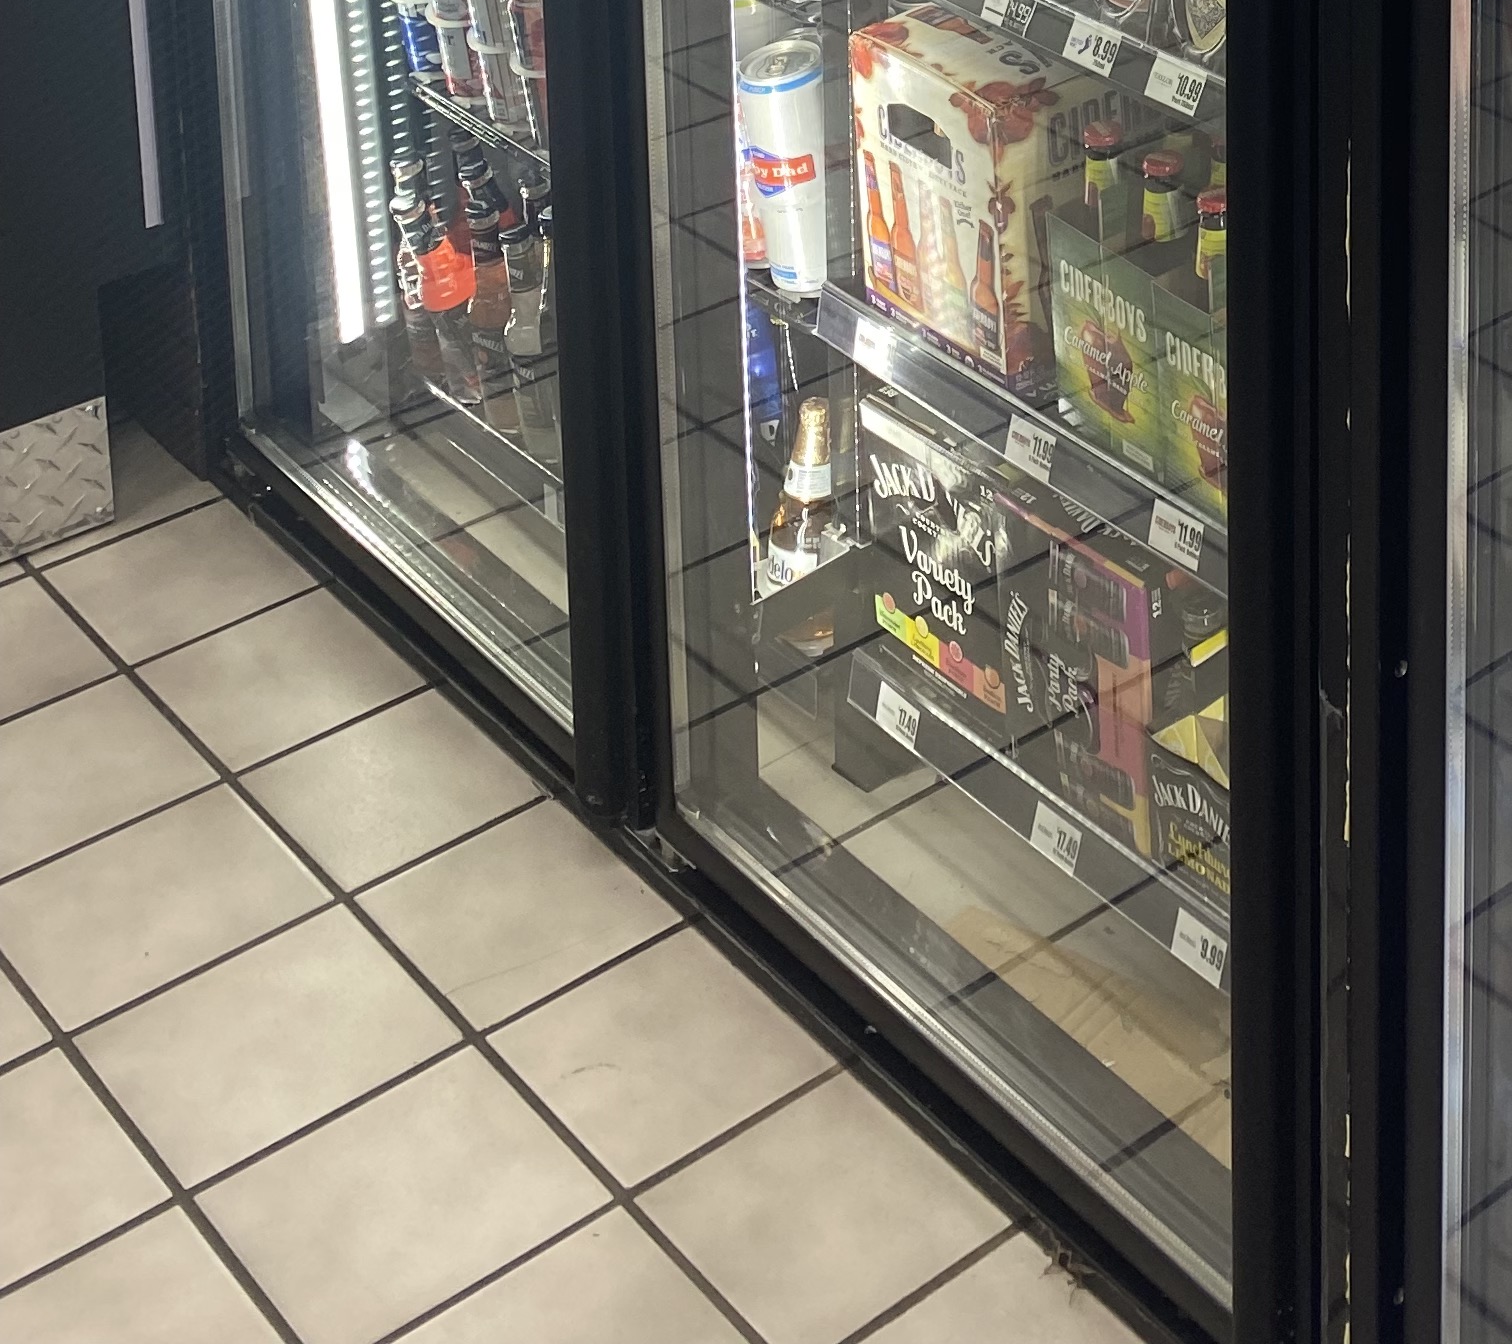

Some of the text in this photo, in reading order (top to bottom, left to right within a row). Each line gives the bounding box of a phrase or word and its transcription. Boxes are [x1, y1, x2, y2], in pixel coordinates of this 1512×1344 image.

[1063, 325, 1114, 369] Caramel
[898, 524, 976, 614] Variety
[911, 570, 968, 636] Pack
[1151, 773, 1188, 812] JACK
